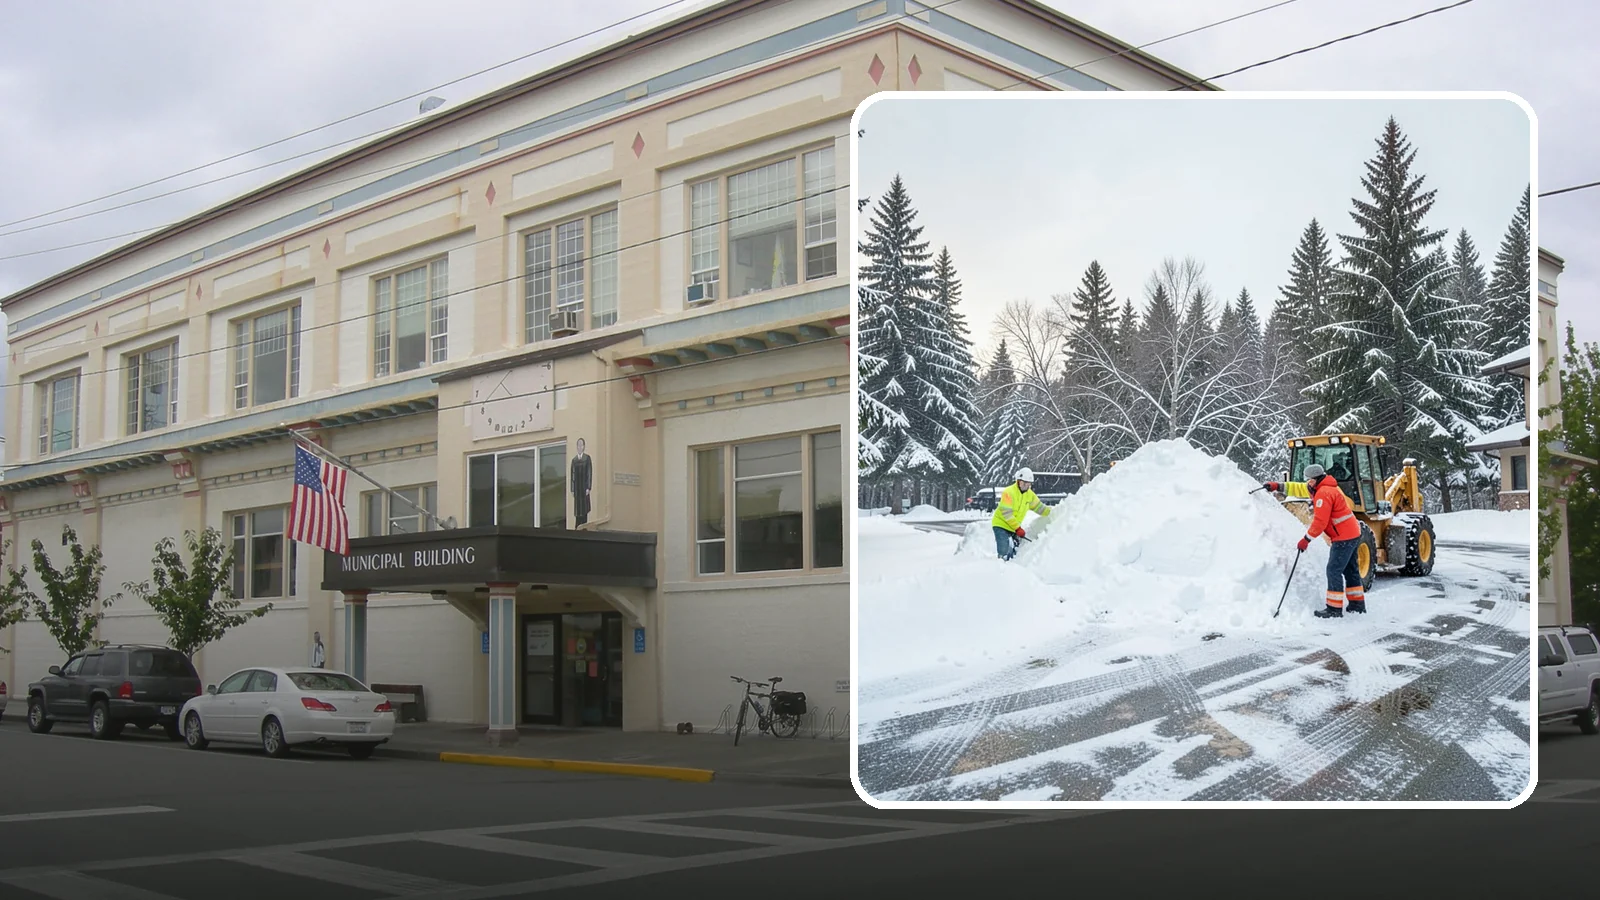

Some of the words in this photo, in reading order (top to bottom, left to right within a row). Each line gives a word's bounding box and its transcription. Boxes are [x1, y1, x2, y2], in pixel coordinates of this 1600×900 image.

[481, 407, 484, 415] 8
[342, 552, 405, 572] MUNICIPAL
[414, 546, 475, 566] BUILDING
